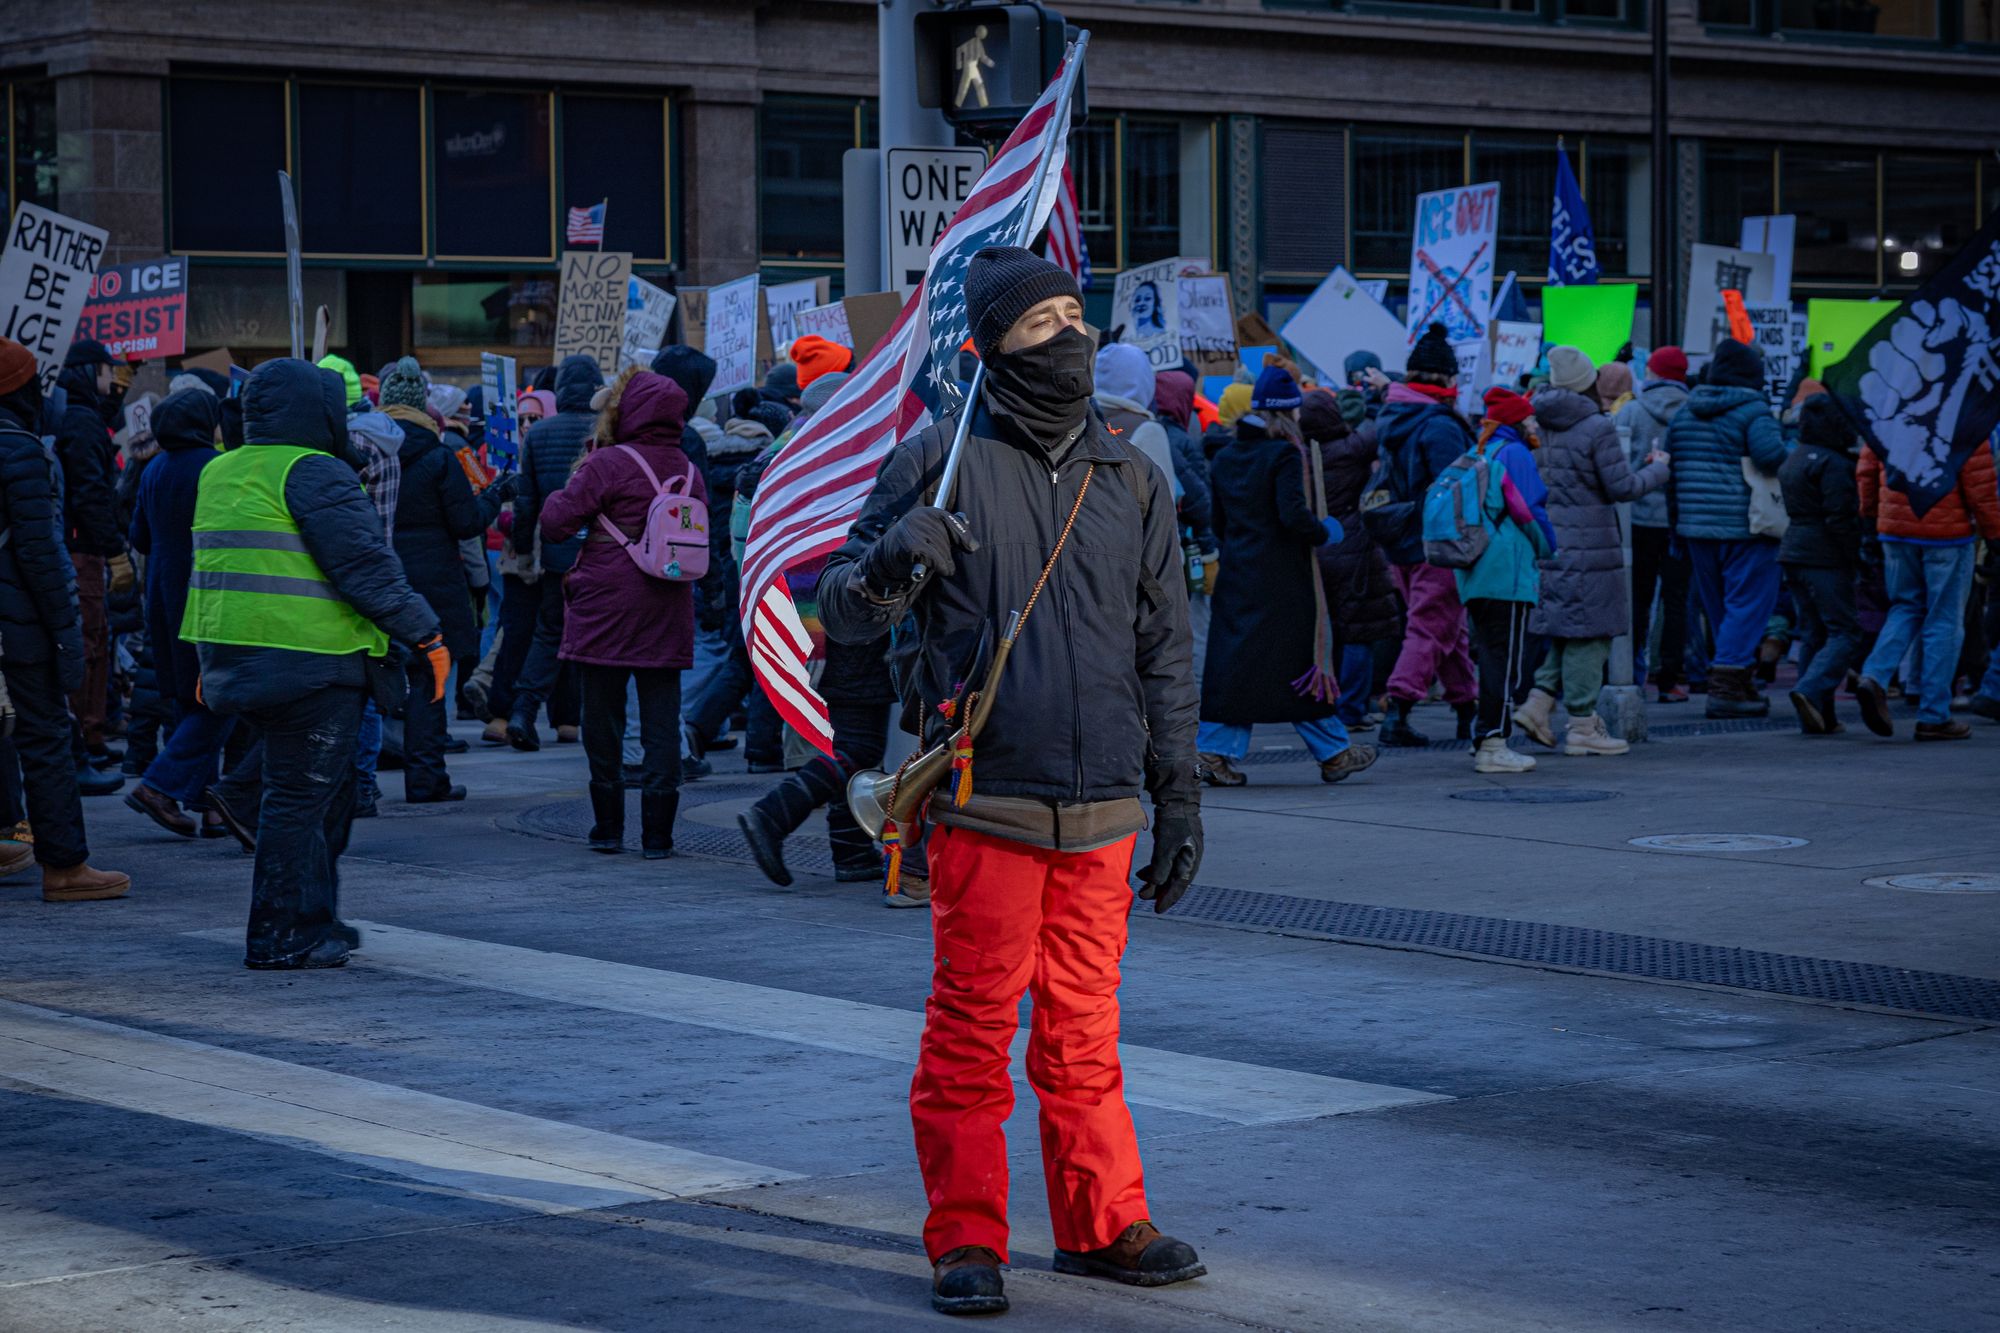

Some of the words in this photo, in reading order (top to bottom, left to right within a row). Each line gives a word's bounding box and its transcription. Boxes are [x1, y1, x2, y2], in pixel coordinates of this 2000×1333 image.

[903, 164, 971, 201] ONE
[901, 211, 957, 247] WA
[1420, 192, 1455, 247] ICE
[1455, 188, 1496, 236] OUT
[14, 212, 102, 273] RATHER
[130, 262, 181, 294] ICE
[567, 255, 621, 280] NO
[1121, 264, 1174, 289] JUSTICE
[25, 263, 70, 310] BE
[562, 281, 624, 304] MORE
[724, 290, 739, 308] NO
[5, 305, 62, 355] ICE
[76, 304, 181, 341] RESIST
[710, 298, 752, 335] HUMAN
[104, 336, 158, 356] ASCISM
[558, 325, 621, 345] ESOTA
